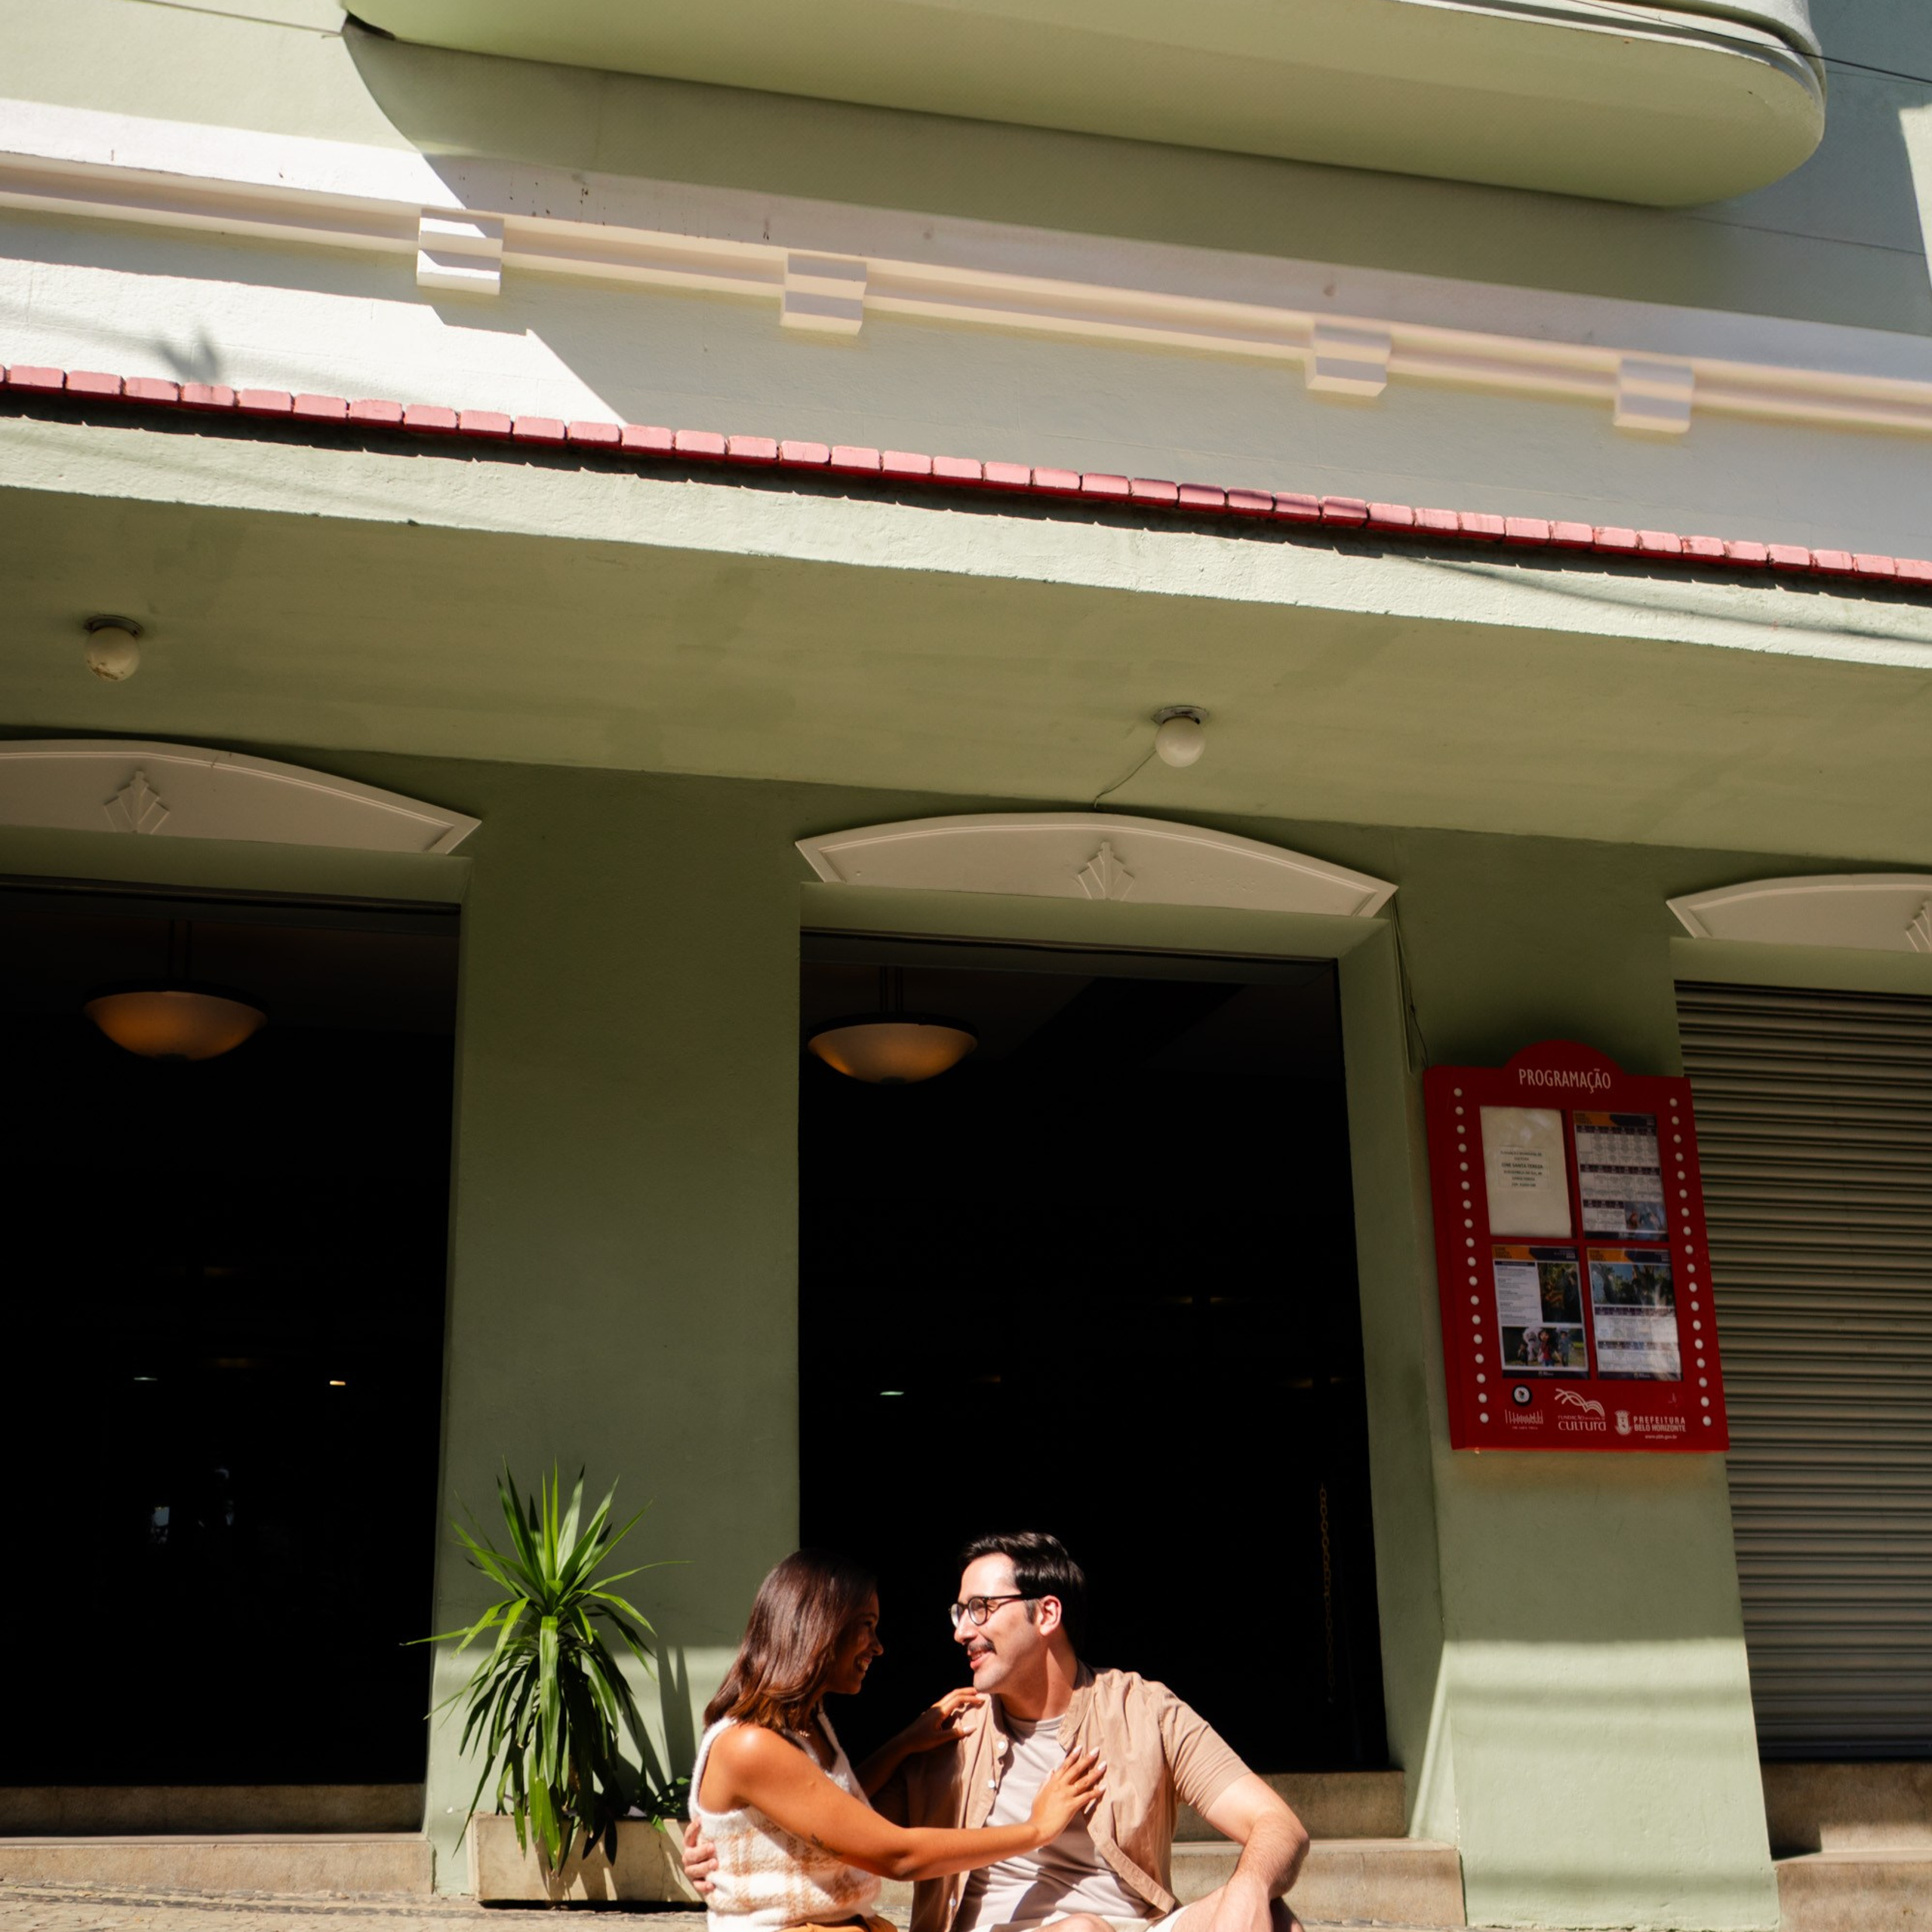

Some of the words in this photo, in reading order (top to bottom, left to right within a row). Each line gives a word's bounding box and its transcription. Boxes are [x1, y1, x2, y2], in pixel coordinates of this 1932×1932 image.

[1518, 1068, 1611, 1094] PROGRAMAÇÃO
[1633, 1416, 1686, 1424] PREFEITURA
[1634, 1423, 1651, 1432] BELO
[1651, 1424, 1687, 1432] HORIZONTE
